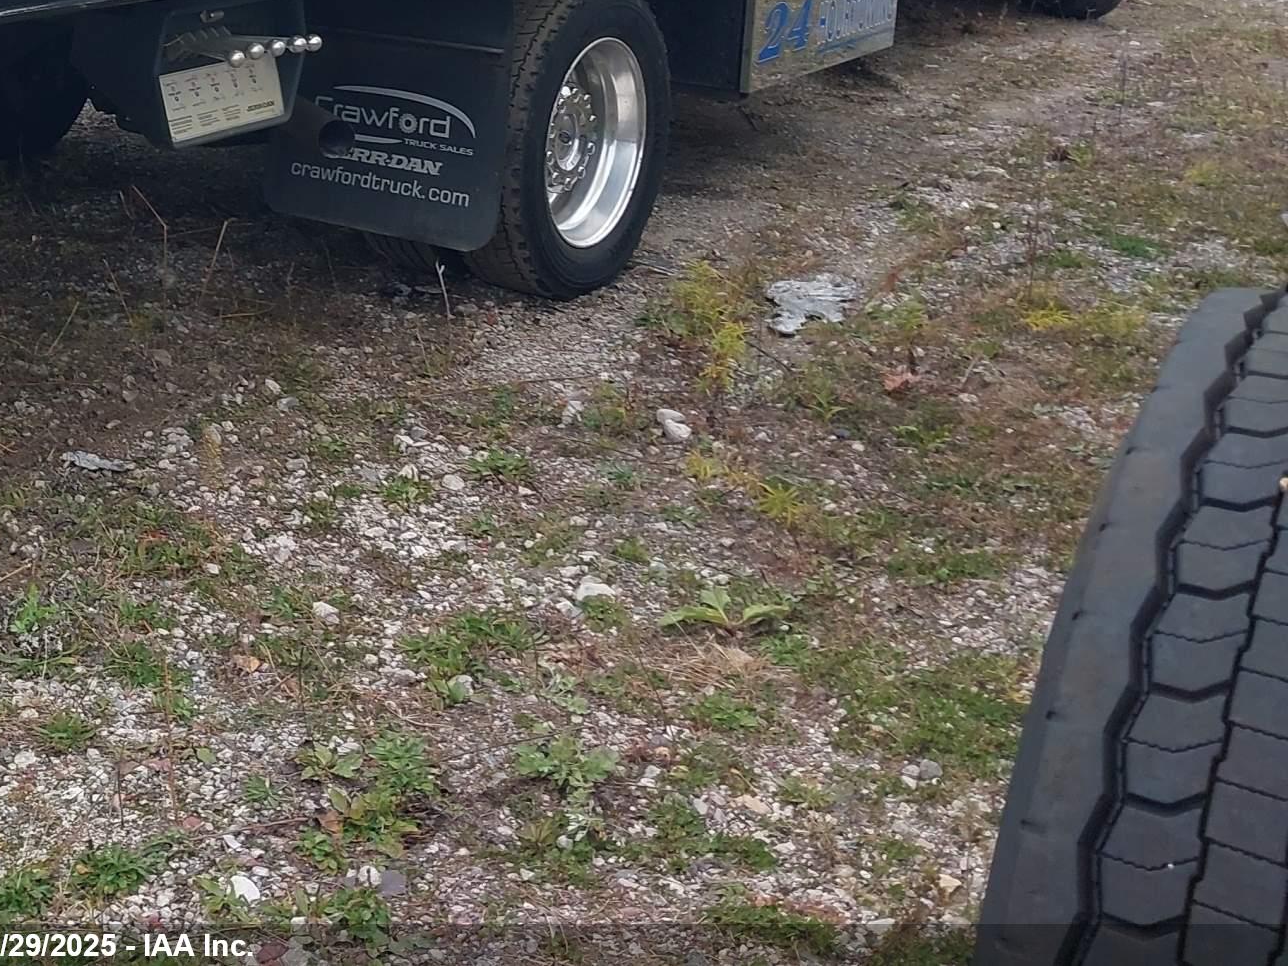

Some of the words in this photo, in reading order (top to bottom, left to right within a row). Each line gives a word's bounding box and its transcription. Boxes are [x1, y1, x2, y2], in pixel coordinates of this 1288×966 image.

[404, 138, 437, 150] TRUCK
[439, 144, 473, 156] SALES
[326, 147, 444, 176] ERR-DAN
